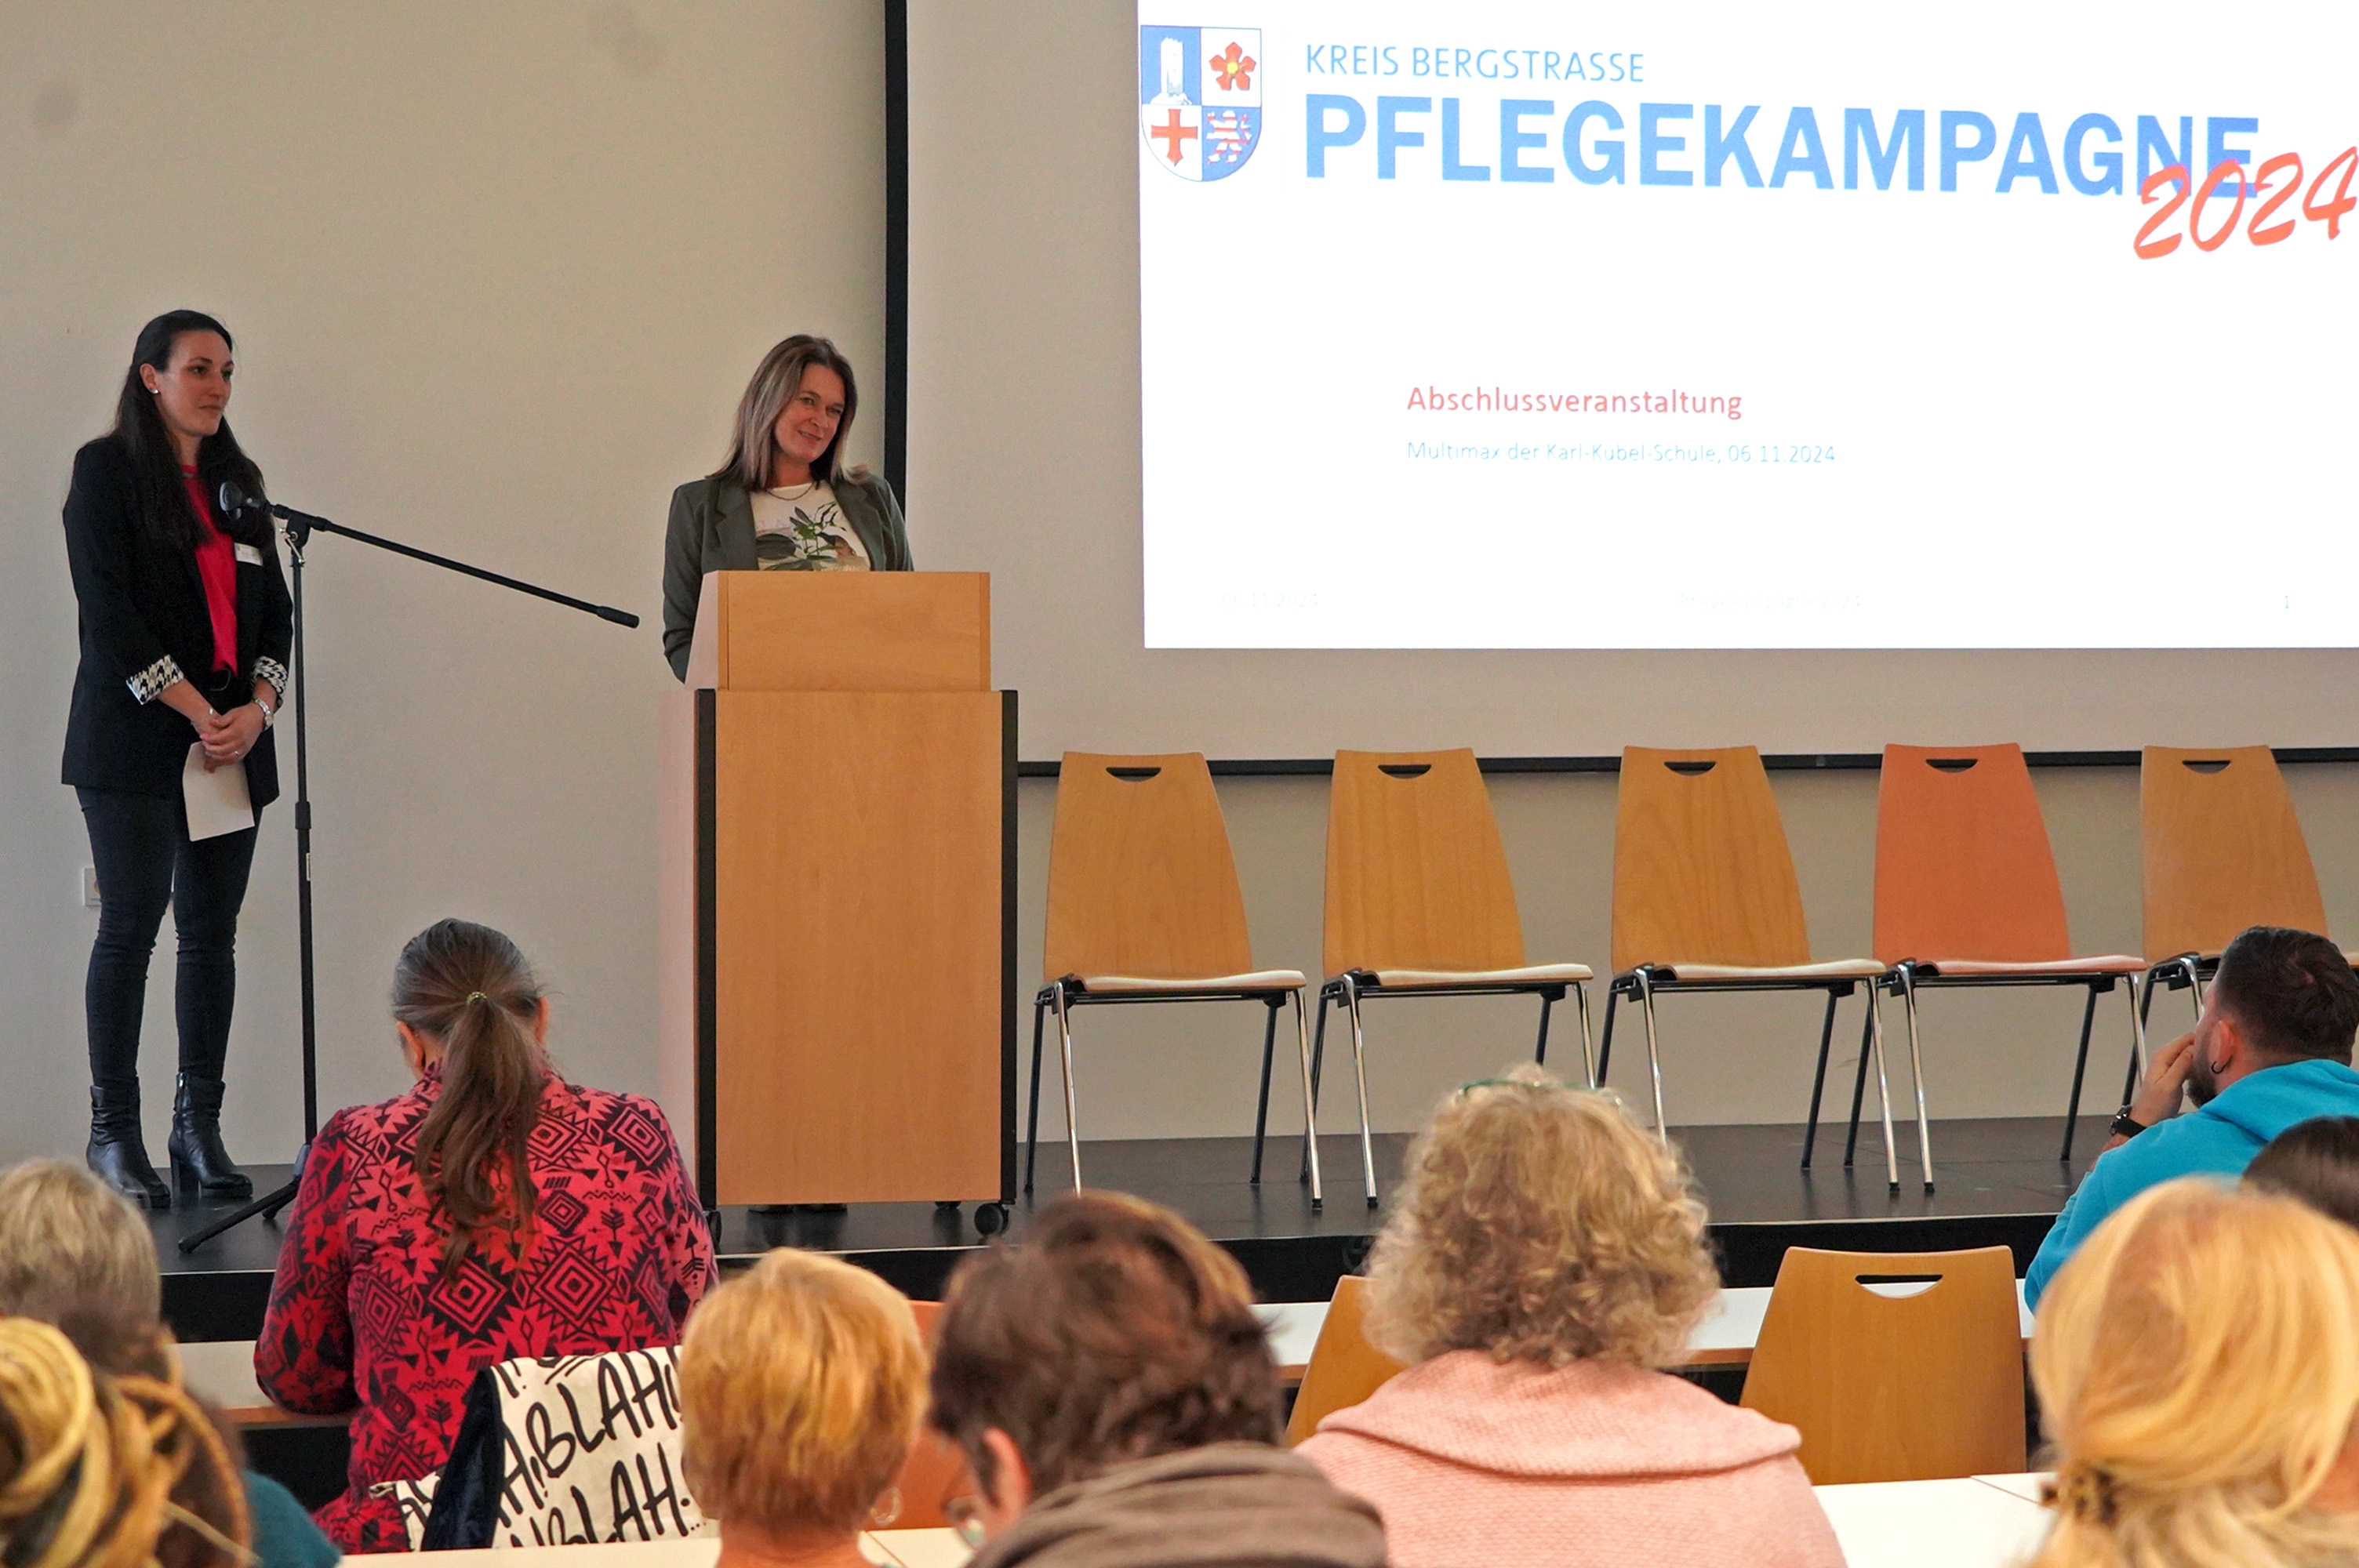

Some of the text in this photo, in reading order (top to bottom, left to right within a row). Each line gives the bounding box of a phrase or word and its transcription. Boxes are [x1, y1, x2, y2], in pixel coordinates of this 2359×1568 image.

[1306, 44, 1645, 83] KREIS BERGSTRASSE
[1306, 93, 2259, 199] PFLEGEKAMPAGNE
[2133, 147, 2358, 260] 2024
[1407, 385, 1743, 421] Abschlussveranstaltung
[1407, 441, 1836, 465] Multimax der Karl-Kübel-Schule, 06.11.2024
